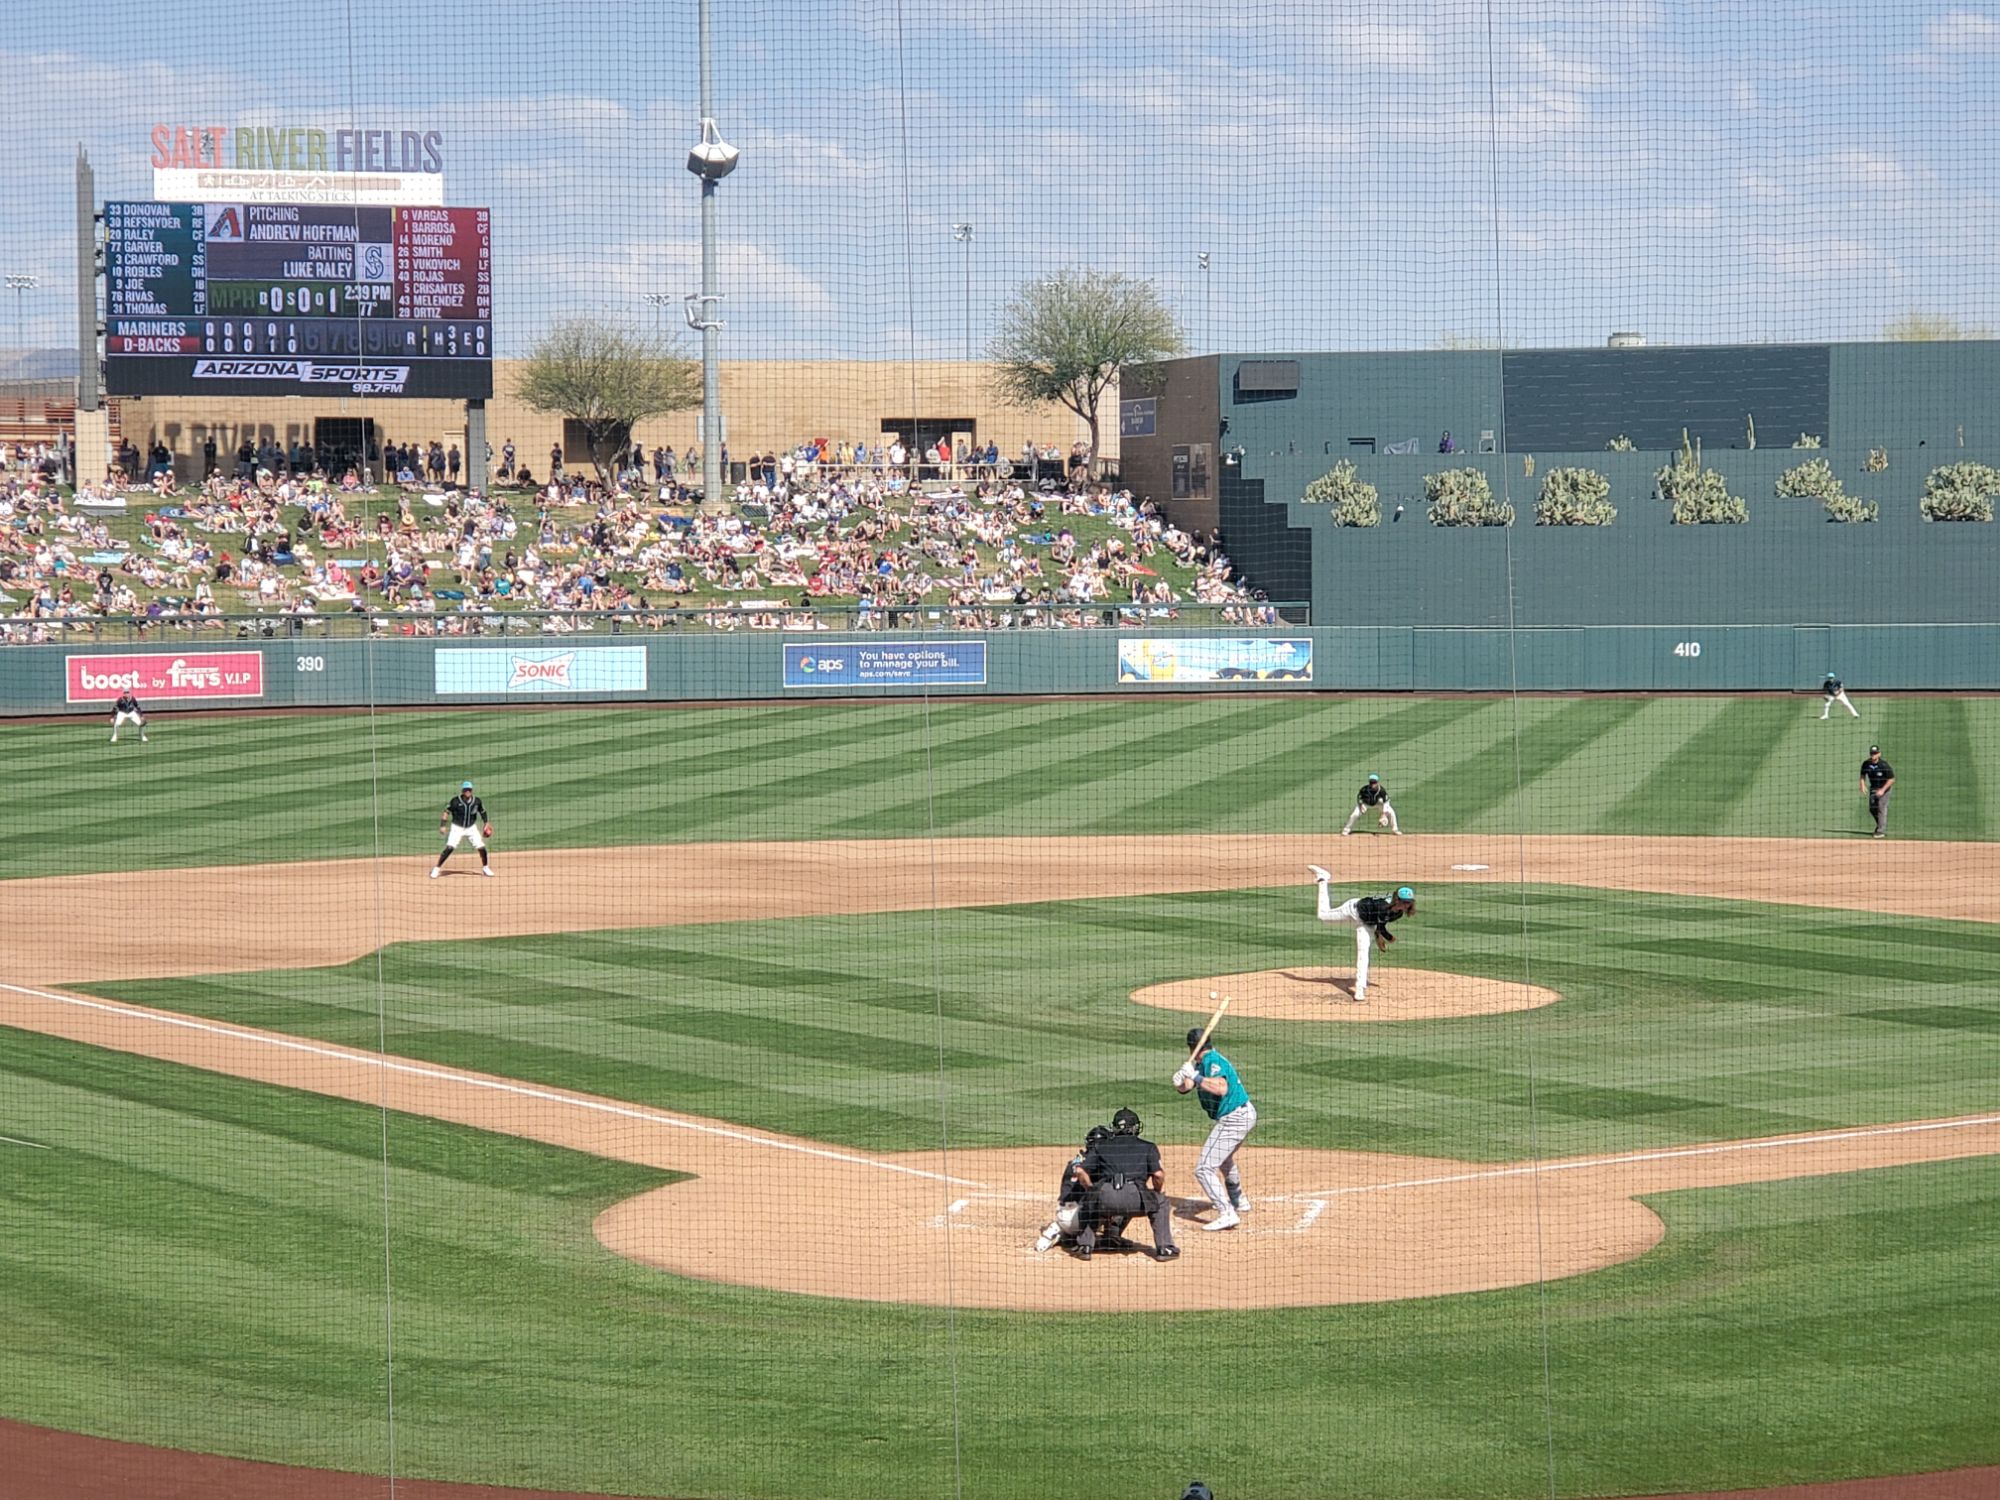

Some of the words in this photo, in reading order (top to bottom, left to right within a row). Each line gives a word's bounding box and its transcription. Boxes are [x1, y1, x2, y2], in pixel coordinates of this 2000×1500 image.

[151, 124, 226, 169] SALT
[235, 126, 328, 172] RIVER
[336, 129, 443, 174] FIELDS
[268, 192, 317, 201] TALKING
[110, 204, 121, 216] 33
[123, 204, 171, 216] DONOVAN
[191, 205, 203, 216] 3B
[250, 207, 299, 222] PITCHING
[411, 210, 448, 221] VARGAS
[476, 211, 488, 221] 3B
[110, 217, 121, 228] 30
[124, 217, 181, 228] REFSNYDER
[192, 218, 203, 228] RF
[404, 223, 408, 233] 1
[412, 223, 456, 233] BARROSA
[477, 223, 488, 234] CF
[110, 229, 121, 240] 20
[124, 229, 154, 240] RALEY
[192, 230, 203, 240] CF
[250, 225, 300, 240] ANDREW
[303, 226, 359, 242] HOFFMAN
[400, 235, 408, 245] 14
[412, 235, 453, 246] MORENO
[482, 236, 488, 246] C
[110, 241, 121, 252] 77
[124, 241, 163, 253] GARVER
[197, 242, 204, 253] C
[398, 247, 409, 257] 26
[412, 247, 443, 257] SMITH
[480, 248, 489, 258] 1B
[115, 254, 122, 265] 3
[124, 254, 179, 265] CRAWFORD
[192, 254, 204, 265] SS
[308, 246, 352, 261] BATTING
[284, 262, 313, 277] LUKE
[316, 263, 352, 278] RALEY
[398, 259, 409, 269] 33
[412, 259, 460, 270] VUKOVICH
[479, 260, 489, 270] LF
[112, 266, 122, 277] 10
[124, 266, 162, 278] ROBLES
[191, 267, 204, 277] DH
[413, 271, 444, 282] ROJAS
[477, 272, 489, 282] SS
[116, 278, 122, 289] 9
[125, 278, 144, 289] JOE
[195, 279, 204, 290] 1B
[404, 283, 410, 293] 5
[413, 283, 465, 294] CRISANTES
[478, 284, 489, 294] 2B
[125, 291, 154, 302] RIVAS
[192, 292, 205, 302] 2B
[344, 286, 370, 300] 2:39
[372, 286, 391, 300] PM
[271, 287, 283, 312] 0
[287, 292, 295, 305] S
[298, 287, 310, 312] 0
[399, 295, 410, 305] 43
[413, 295, 463, 307] MELENDEZ
[477, 296, 489, 306] DH
[113, 303, 122, 314] 31
[125, 303, 167, 314] THOMAS
[195, 304, 205, 314] LF
[414, 307, 441, 318] ORTIZ
[479, 308, 490, 318] RF
[118, 321, 186, 336] MARINERS
[206, 322, 214, 336] 0
[224, 322, 232, 336] 0
[244, 322, 252, 336] 0
[268, 322, 276, 336] 0
[448, 325, 456, 338] 3
[476, 326, 484, 339] 0
[407, 332, 416, 345] R
[434, 332, 443, 345] H
[464, 333, 471, 346] E
[124, 338, 180, 352] D-BACKS
[206, 338, 214, 352] 0
[224, 338, 233, 352] 0
[244, 338, 252, 352] 0
[288, 339, 296, 353] 0
[448, 341, 456, 354] 3
[476, 342, 484, 355] 0
[201, 362, 299, 375] ARIZONA
[309, 368, 398, 381] SPORTS
[352, 383, 403, 393] 98.7FM
[860, 651, 878, 660] You
[881, 651, 905, 660] have
[908, 650, 945, 661] options
[1674, 642, 1701, 657] 410
[297, 656, 324, 672] 390
[818, 659, 844, 672] aps
[860, 660, 870, 668] to
[873, 660, 912, 670] manage
[916, 660, 938, 669] your
[81, 665, 140, 689] boost
[152, 677, 165, 688] by
[166, 659, 221, 689] fry's
[516, 664, 566, 678] SONIC
